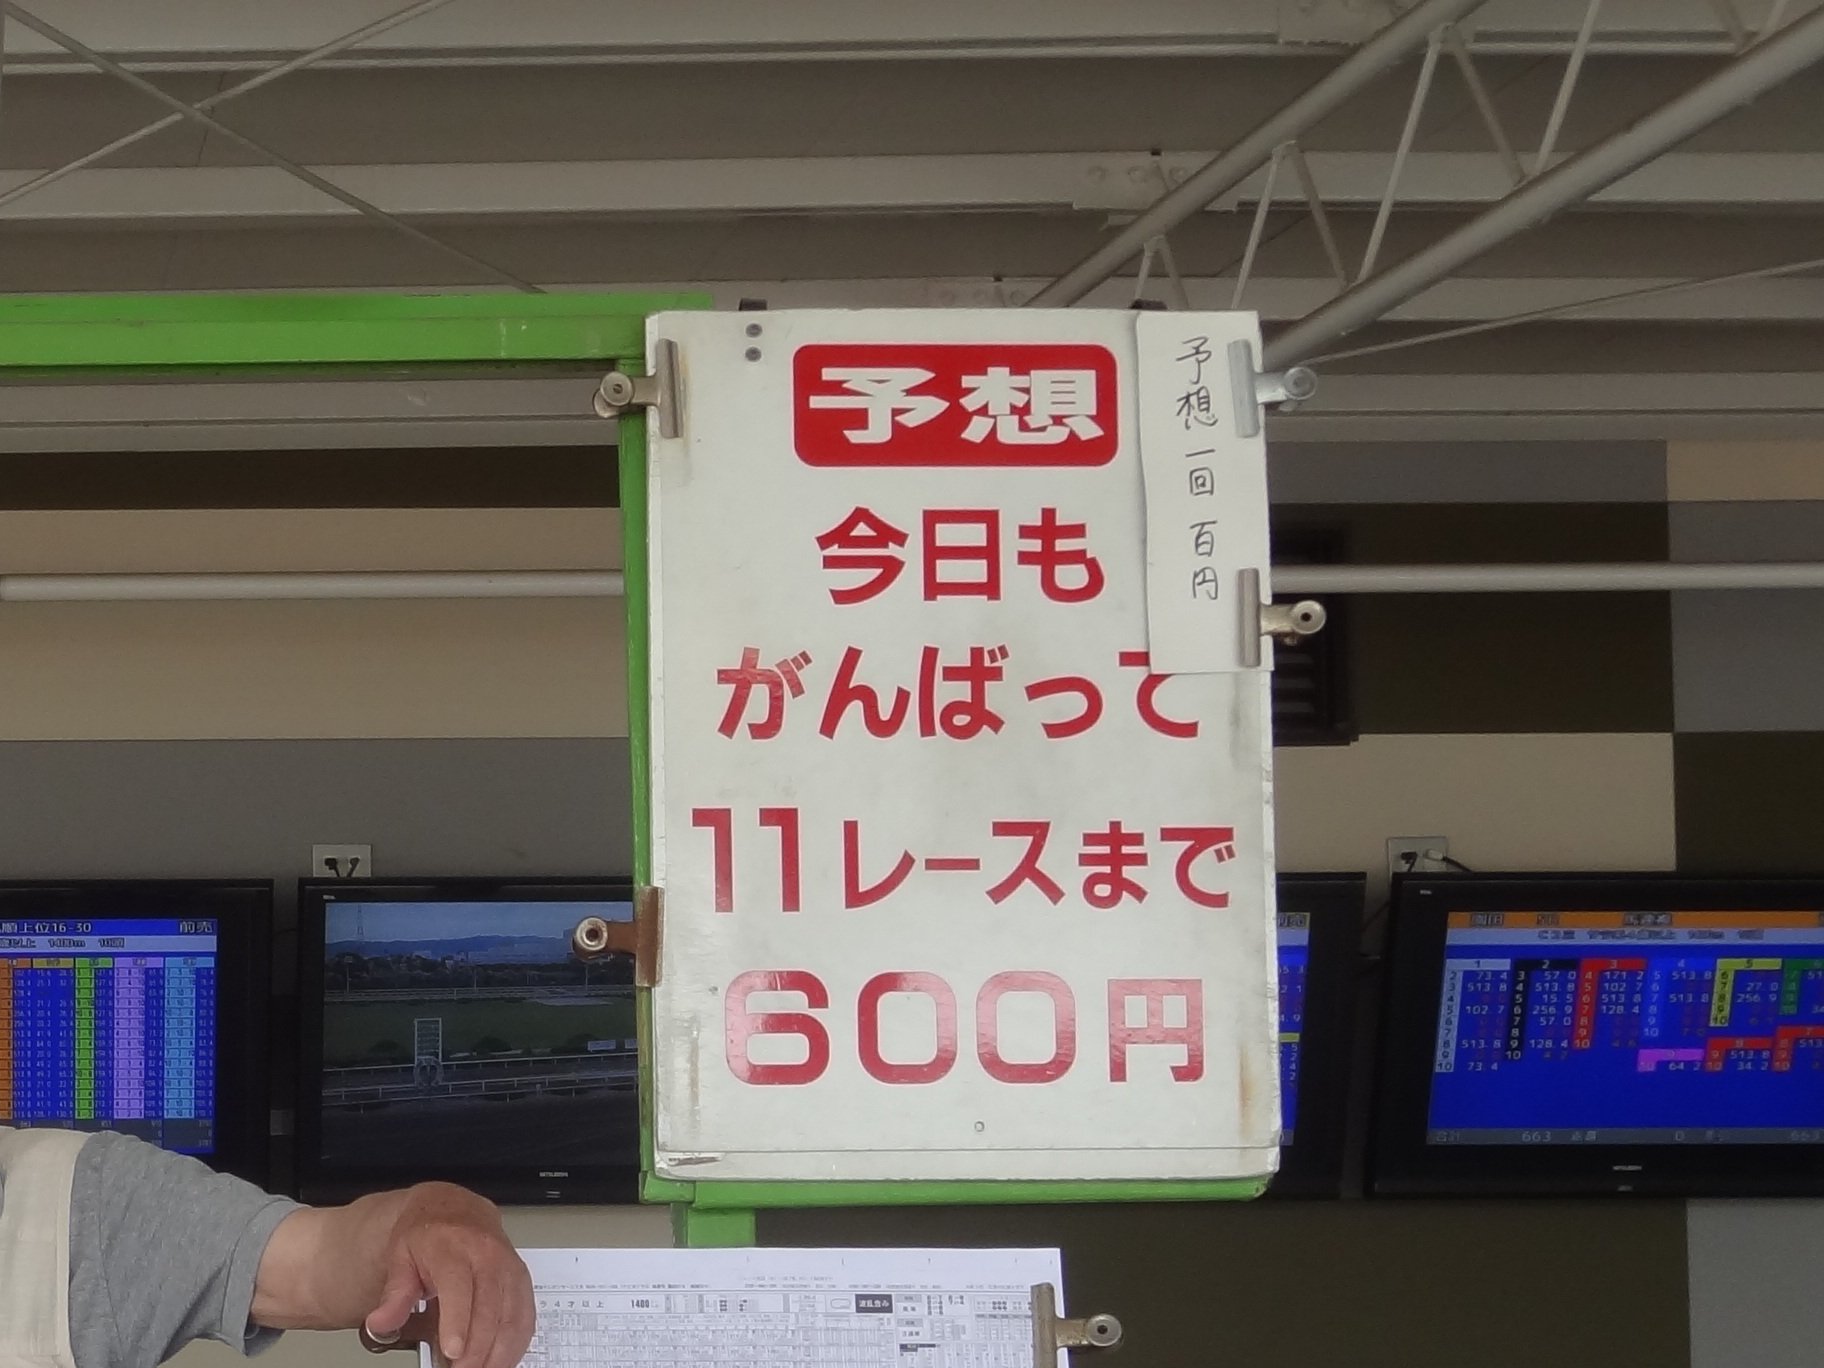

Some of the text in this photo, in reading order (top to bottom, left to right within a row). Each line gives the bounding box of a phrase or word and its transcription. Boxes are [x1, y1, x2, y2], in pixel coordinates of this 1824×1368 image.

[808, 366, 1106, 446] 予想
[816, 507, 1106, 605] 今日も
[715, 645, 1202, 741] がんばって
[691, 807, 1239, 915] 11レースまで
[724, 970, 1207, 1087] 600円
[1521, 1131, 1553, 1143] 663
